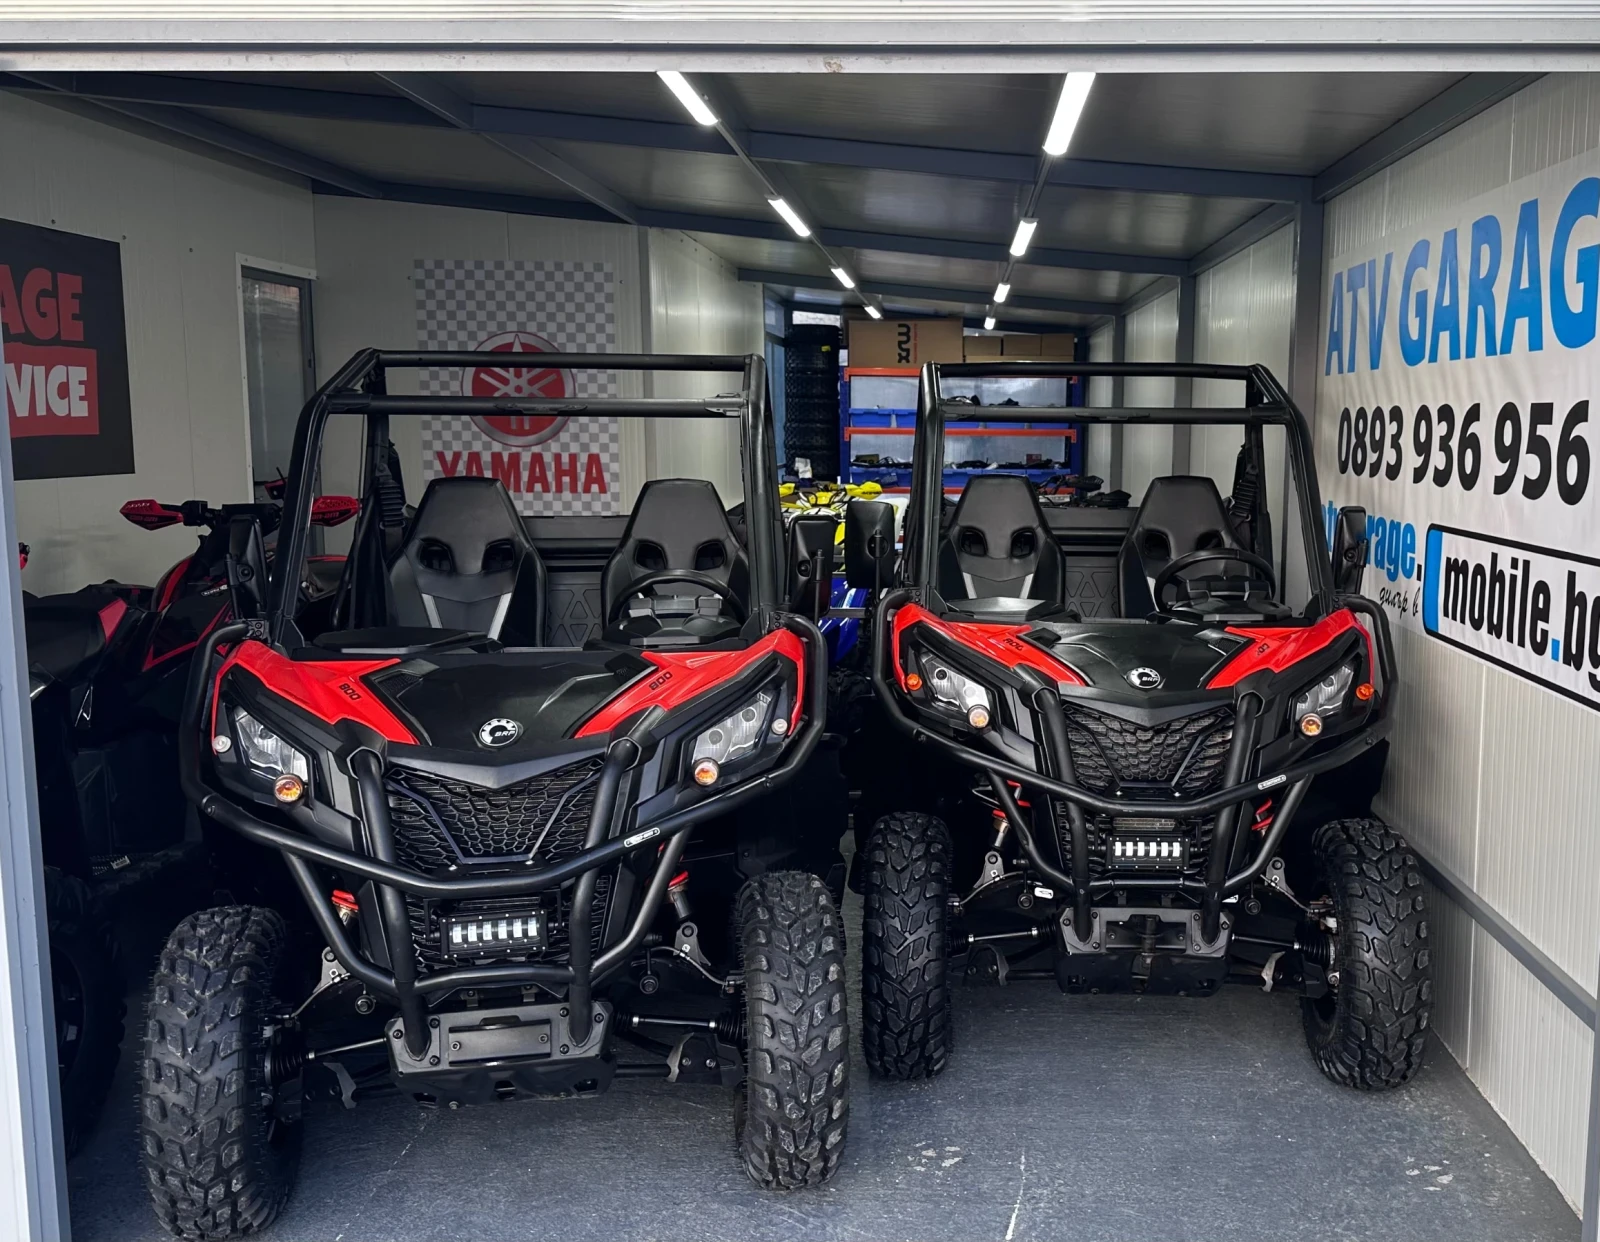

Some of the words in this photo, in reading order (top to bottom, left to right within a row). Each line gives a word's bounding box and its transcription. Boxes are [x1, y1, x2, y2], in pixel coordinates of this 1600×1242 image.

[1325, 252, 1393, 376] ATV
[1399, 177, 1600, 367] GARAG
[436, 451, 607, 494] YAMAHA
[1338, 405, 1403, 481] 0893
[1413, 403, 1481, 491] 936
[1493, 400, 1590, 505] 956
[339, 682, 362, 700] 800
[649, 671, 673, 690] 800
